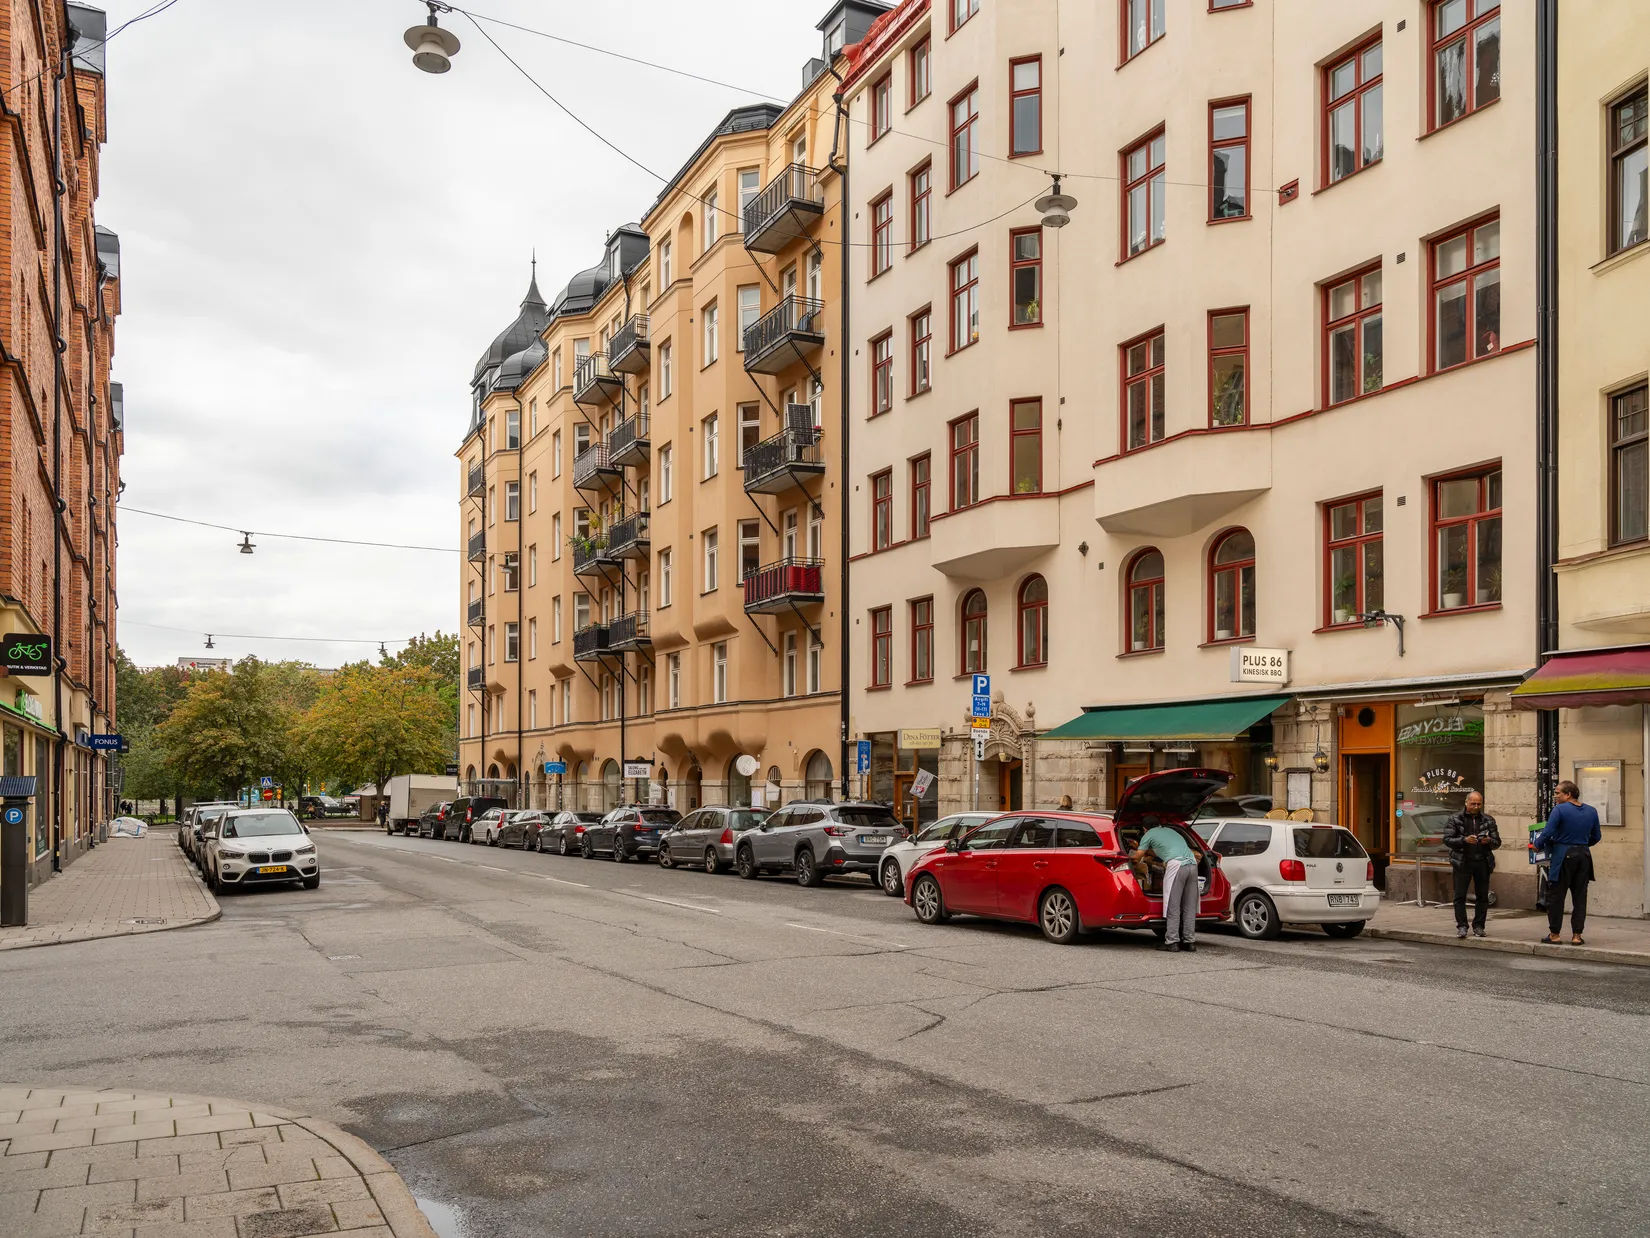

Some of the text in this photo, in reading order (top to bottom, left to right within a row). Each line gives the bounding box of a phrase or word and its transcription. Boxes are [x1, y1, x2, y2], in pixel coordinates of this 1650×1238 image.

[1243, 655, 1283, 667] PLUS 86
[1242, 668, 1283, 677] KINESISK BBQ
[977, 676, 988, 693] P
[1426, 768, 1457, 779] PLUS 86
[9, 811, 19, 821] P
